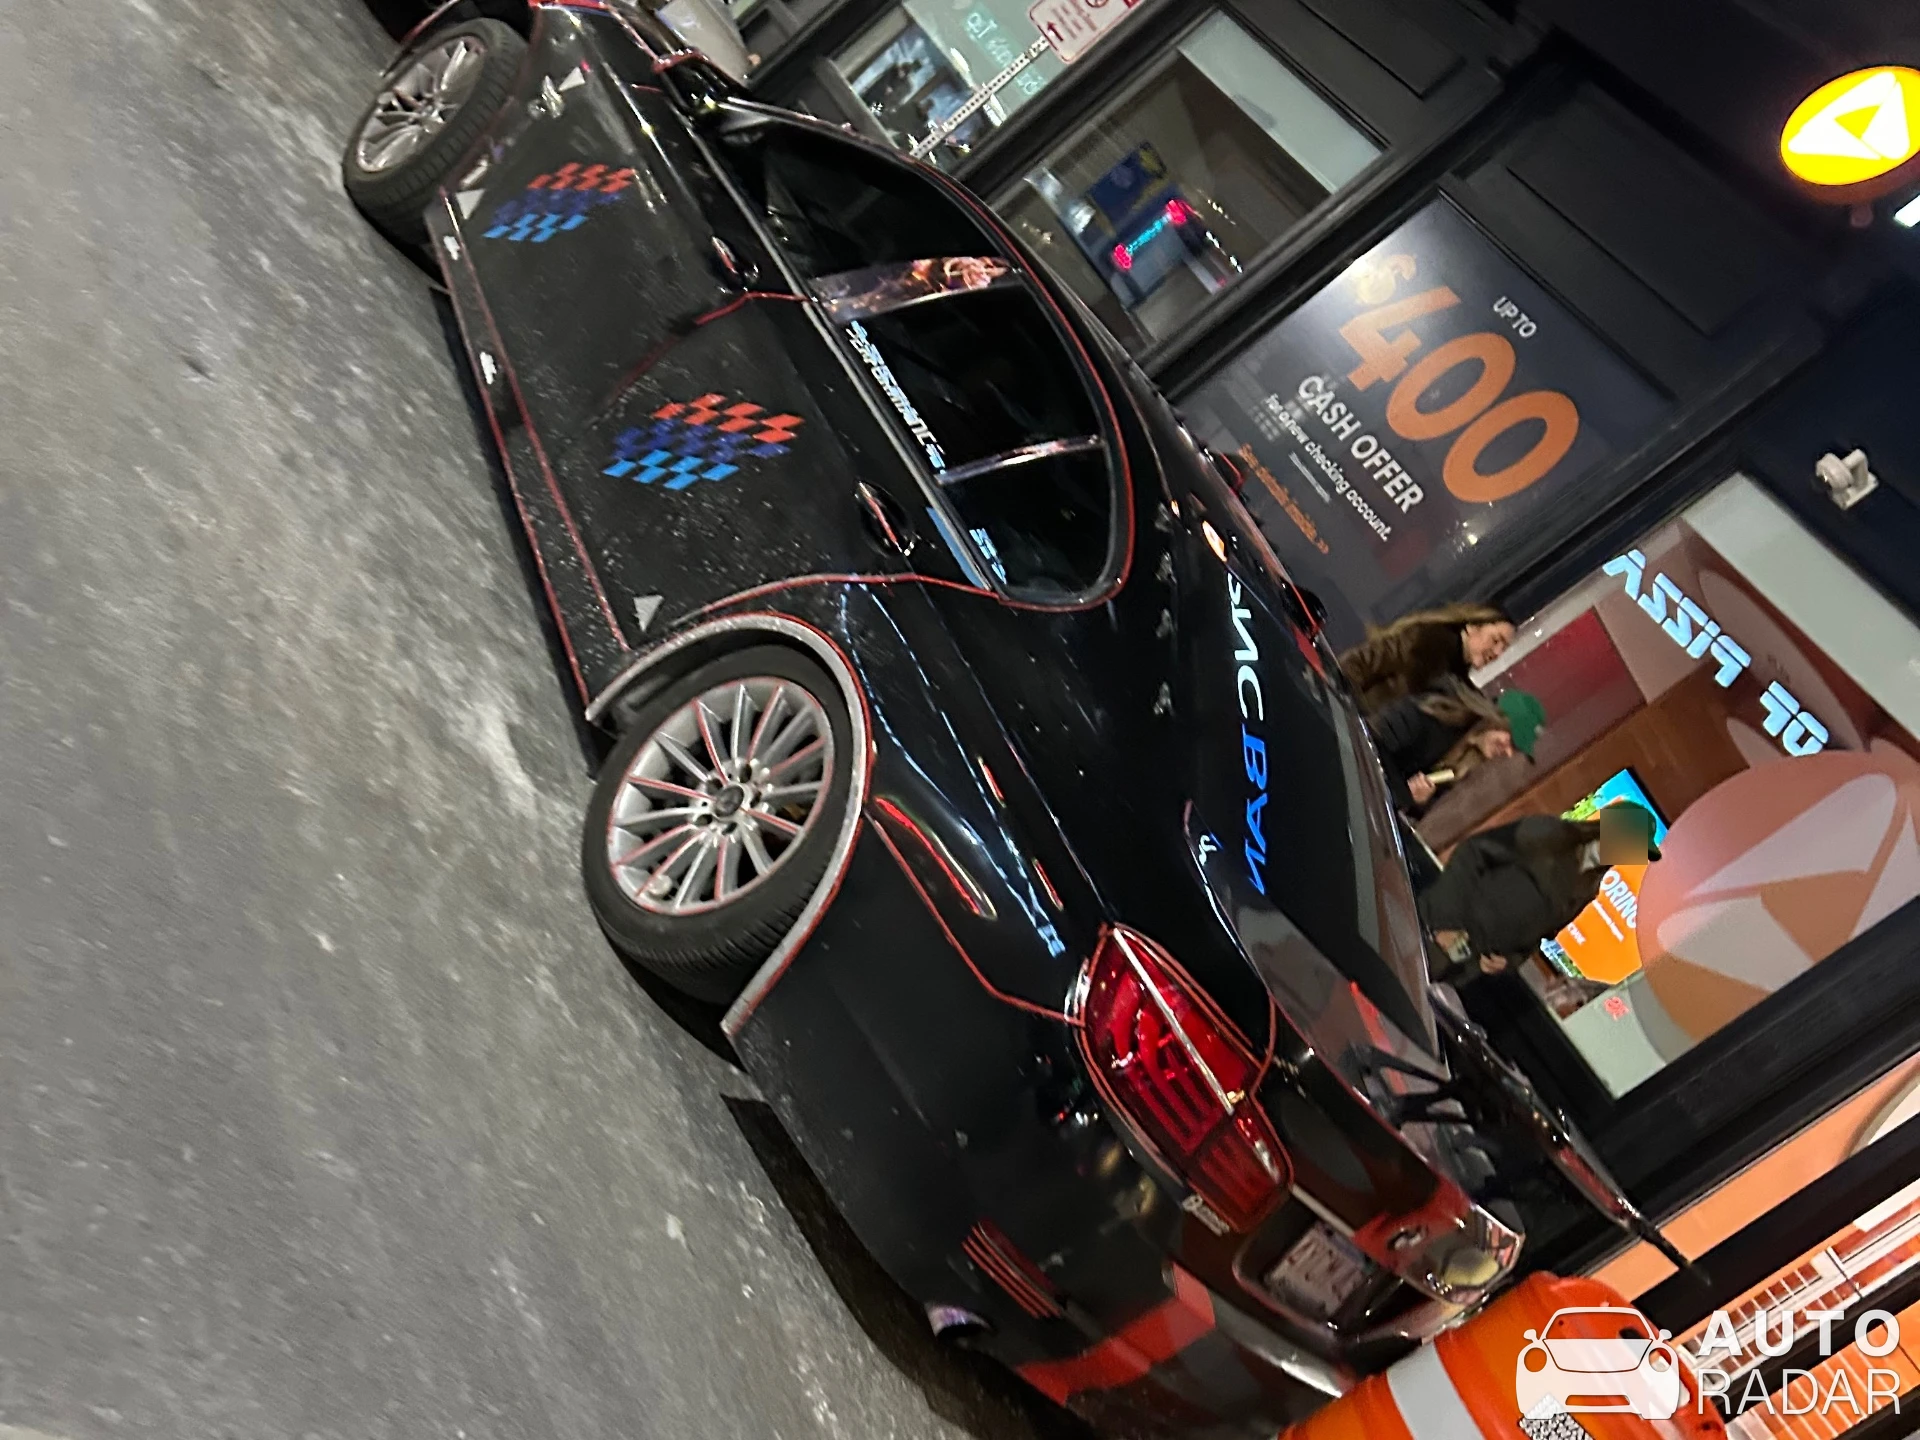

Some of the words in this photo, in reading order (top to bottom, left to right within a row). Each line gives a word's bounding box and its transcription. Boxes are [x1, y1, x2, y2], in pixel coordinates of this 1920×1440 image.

[1339, 253, 1579, 503] $400
[1492, 294, 1519, 318] UP
[1511, 312, 1536, 337] TO
[1286, 419, 1309, 443] new
[1305, 441, 1350, 495] checking
[1346, 489, 1392, 541] account.
[1298, 376, 1361, 441] CASH
[1351, 434, 1424, 514] OFFER
